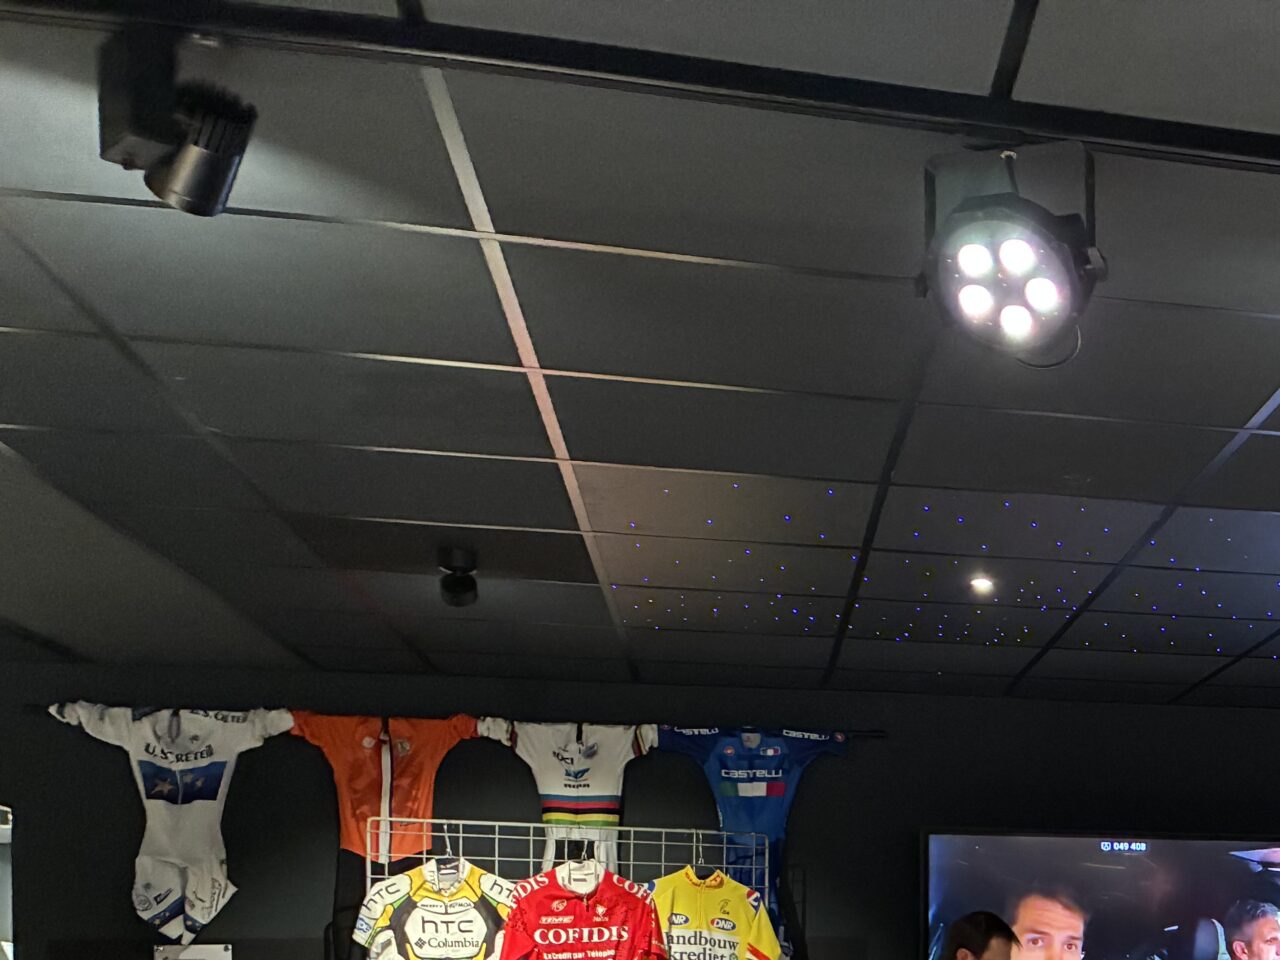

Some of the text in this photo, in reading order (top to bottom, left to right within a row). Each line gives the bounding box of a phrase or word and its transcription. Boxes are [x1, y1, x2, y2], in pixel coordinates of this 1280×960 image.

[712, 919, 735, 931] DNR
[533, 925, 629, 945] COFIDIS
[428, 936, 480, 949] Columbia
